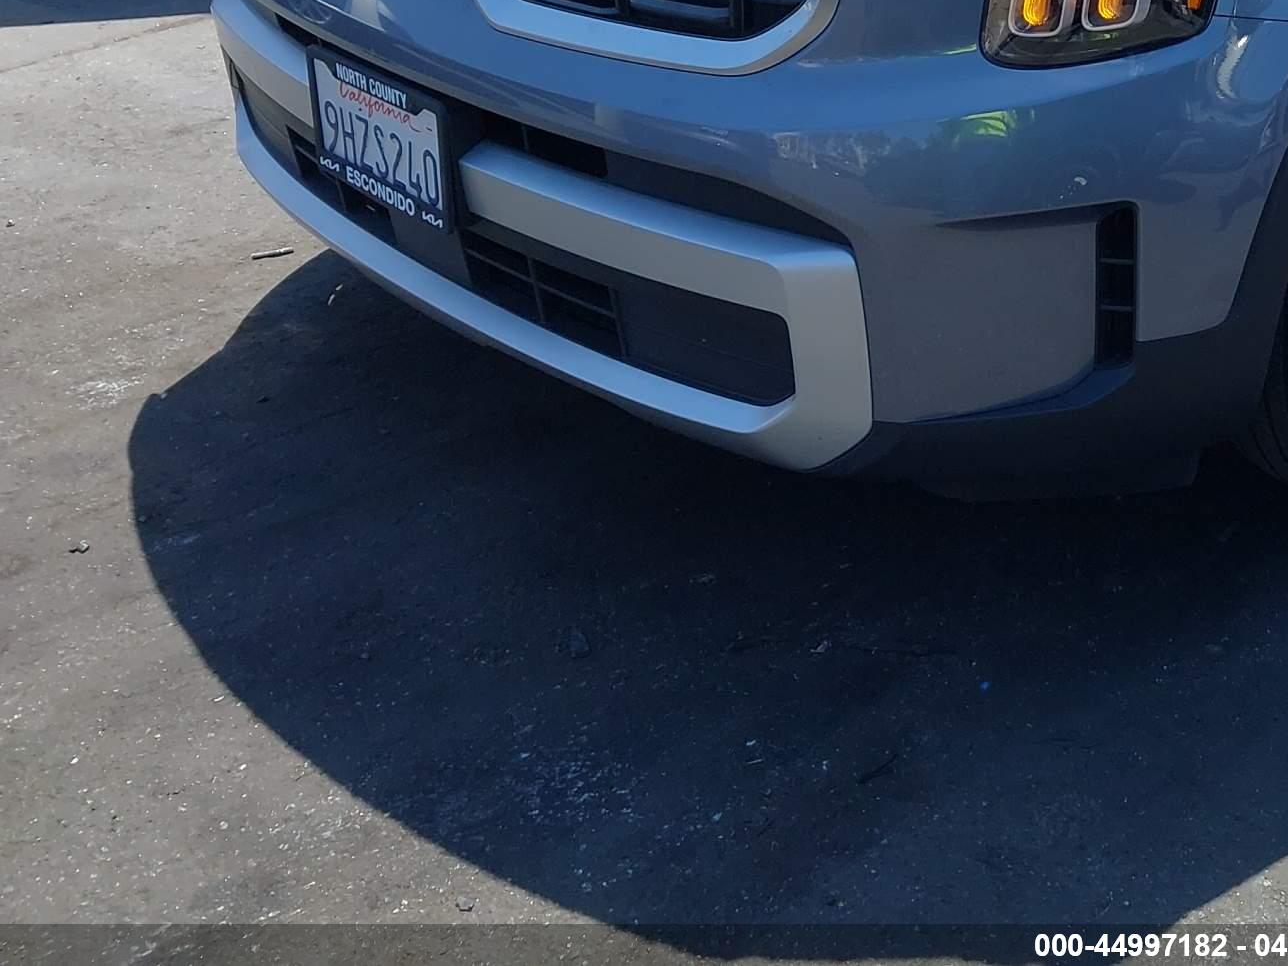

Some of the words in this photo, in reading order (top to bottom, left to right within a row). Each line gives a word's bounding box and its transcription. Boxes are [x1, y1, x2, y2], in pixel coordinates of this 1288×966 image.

[335, 62, 368, 91] NORTH
[368, 78, 408, 109] COUNTY
[340, 81, 421, 133] California
[324, 100, 439, 206] 9HZS240
[346, 166, 416, 217] ESCONDIDO
